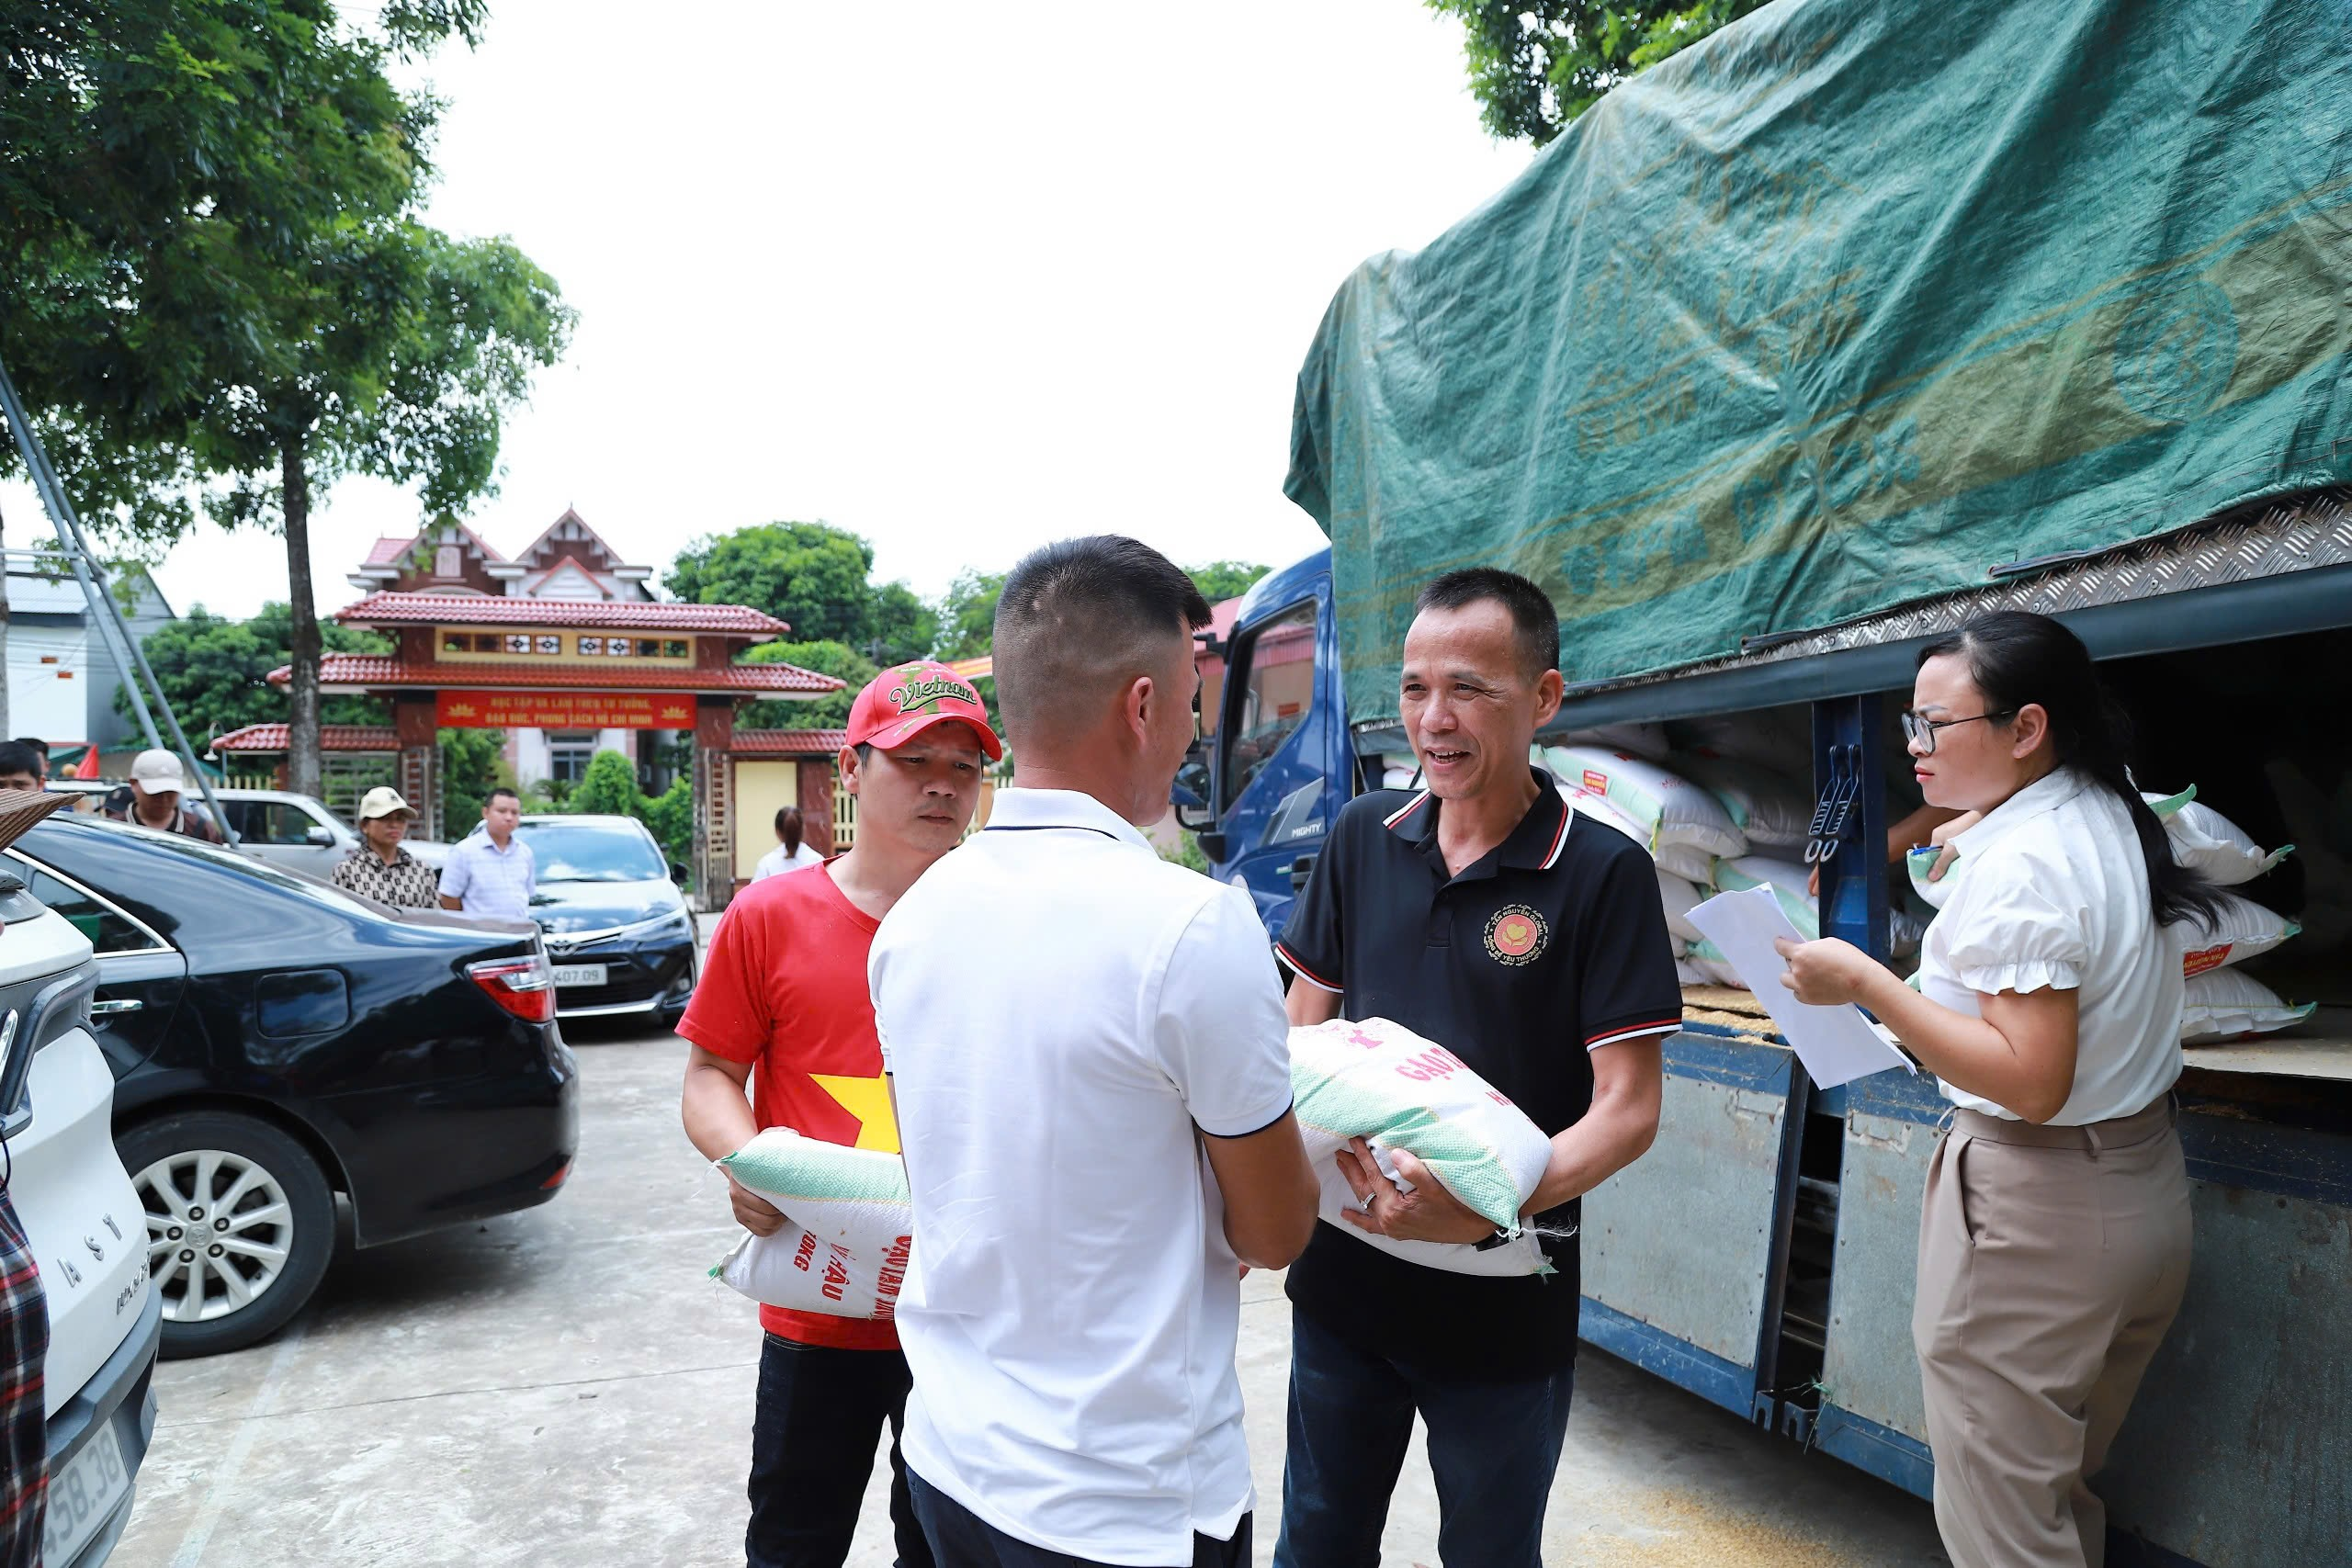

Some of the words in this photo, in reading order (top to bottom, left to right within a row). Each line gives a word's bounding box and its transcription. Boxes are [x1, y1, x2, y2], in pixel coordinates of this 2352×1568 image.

[889, 675, 976, 709] Vietnam
[1291, 822, 1322, 838] MIGHTY
[1530, 915, 1544, 936] GLOBAL
[1396, 1053, 1454, 1080] GẠO
[794, 1229, 818, 1272] 10KG
